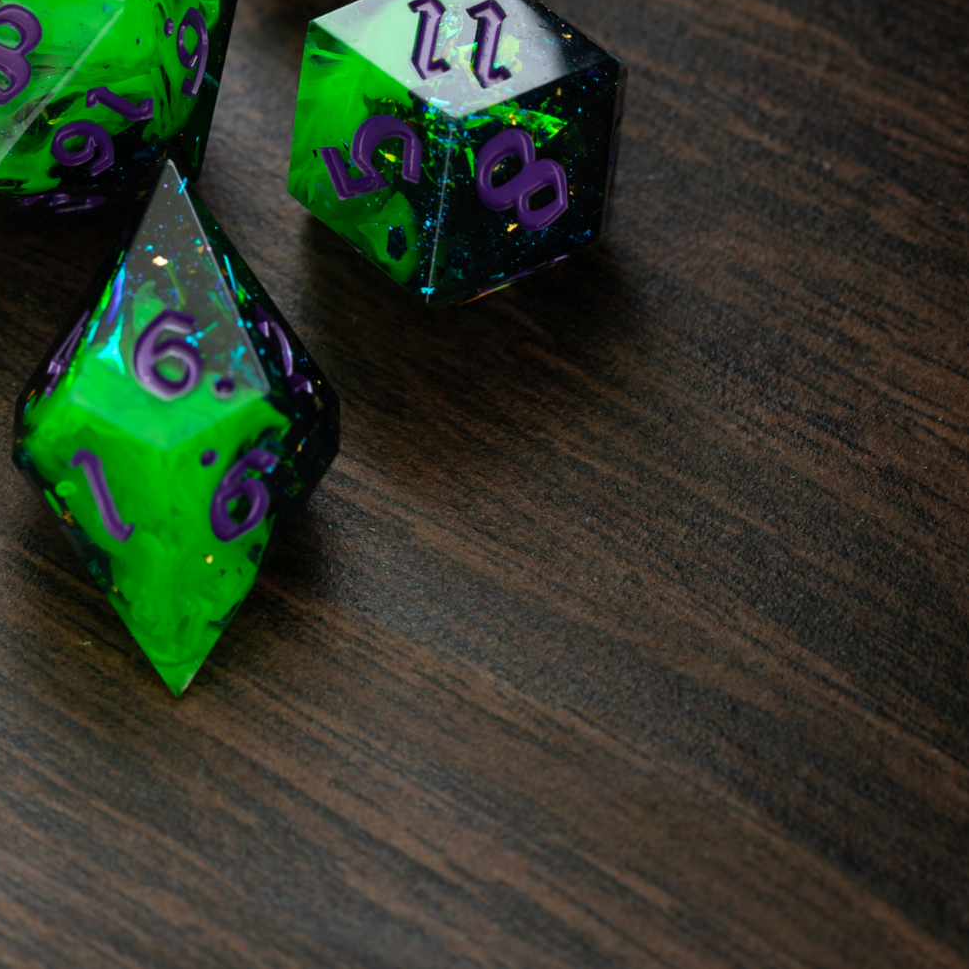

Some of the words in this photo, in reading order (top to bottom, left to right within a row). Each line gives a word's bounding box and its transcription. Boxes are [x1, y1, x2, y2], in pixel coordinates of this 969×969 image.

[51, 86, 155, 177] 16
[476, 128, 569, 231] 8
[69, 447, 135, 543] 1
